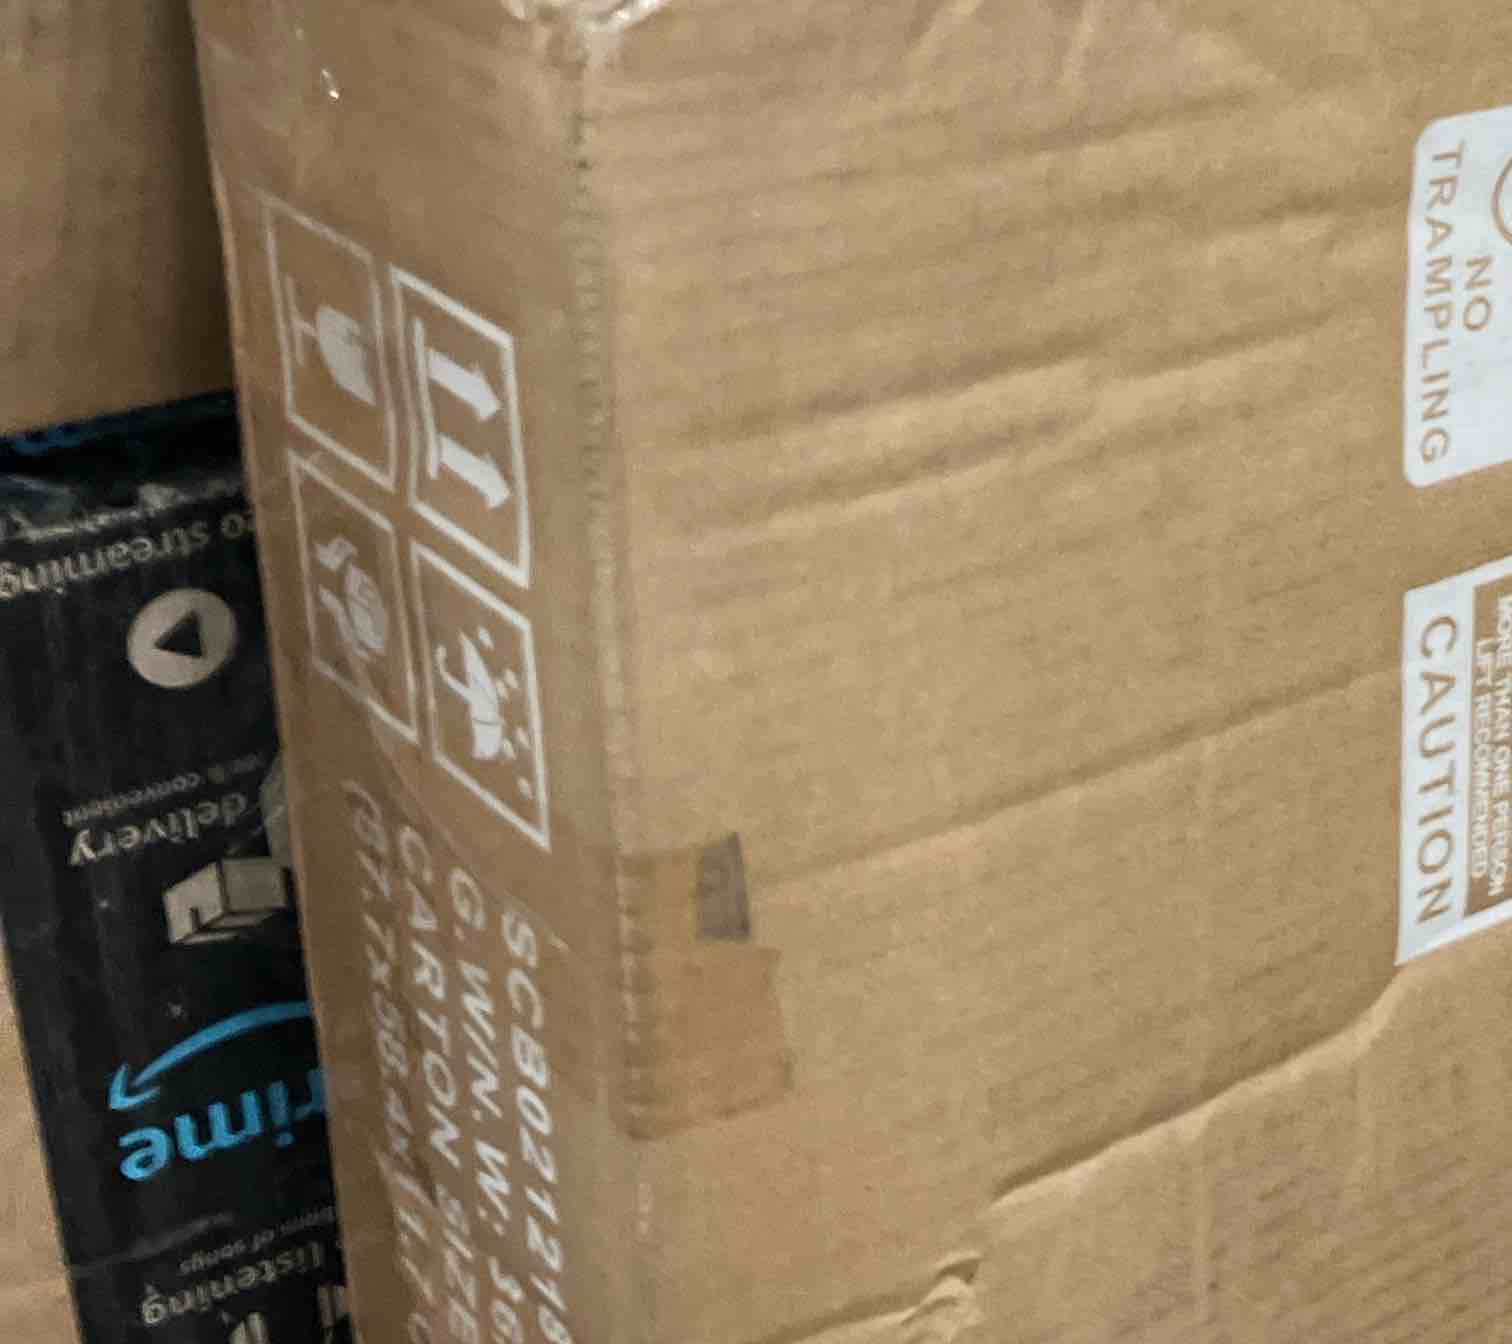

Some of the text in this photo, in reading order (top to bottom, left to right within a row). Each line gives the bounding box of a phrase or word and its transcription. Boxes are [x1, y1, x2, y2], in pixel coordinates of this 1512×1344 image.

[1420, 139, 1465, 464] TRAMPLING
[1463, 248, 1494, 333] NO
[1493, 677, 1512, 741] THAN
[1415, 615, 1458, 925] CAUTION
[1471, 638, 1495, 879] LIFT RECOMMENDED
[1491, 744, 1511, 796] ONE
[69, 791, 248, 866] delivery
[1487, 800, 1509, 897] PERSON
[400, 824, 461, 1170] CARTON
[118, 1065, 328, 1183] rime
[140, 1241, 323, 1326] listening
